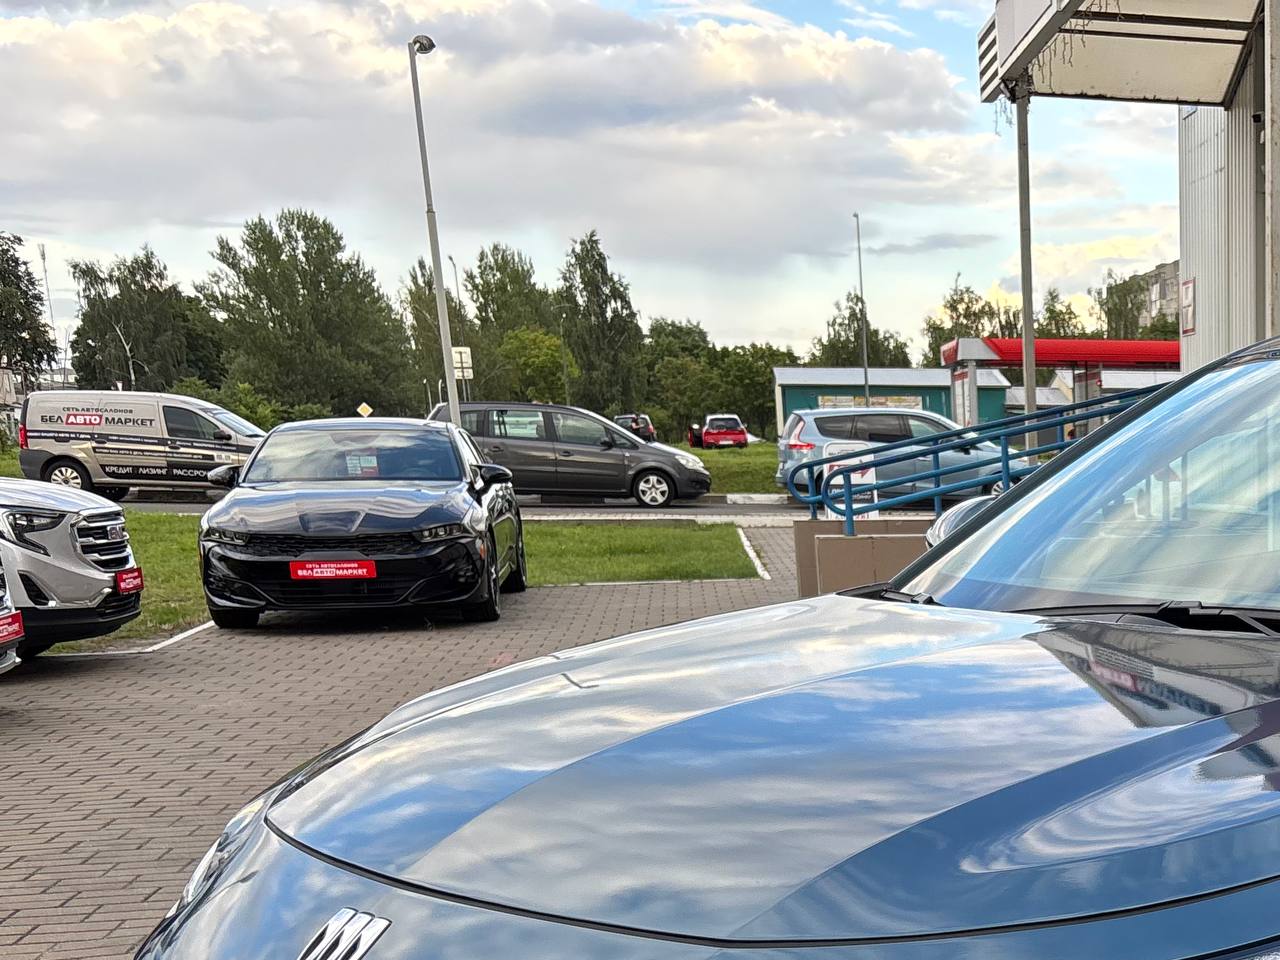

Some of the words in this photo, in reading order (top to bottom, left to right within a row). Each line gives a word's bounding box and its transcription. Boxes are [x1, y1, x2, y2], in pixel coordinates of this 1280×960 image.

[81, 407, 134, 415] АВТОСАЛОНОВ
[40, 414, 64, 424] БЕЛ
[66, 415, 100, 425] АВТО
[104, 417, 155, 427] МАРКЕТ
[105, 466, 133, 475] КРЕДИТ
[138, 467, 168, 476] ЛИЗИНГ
